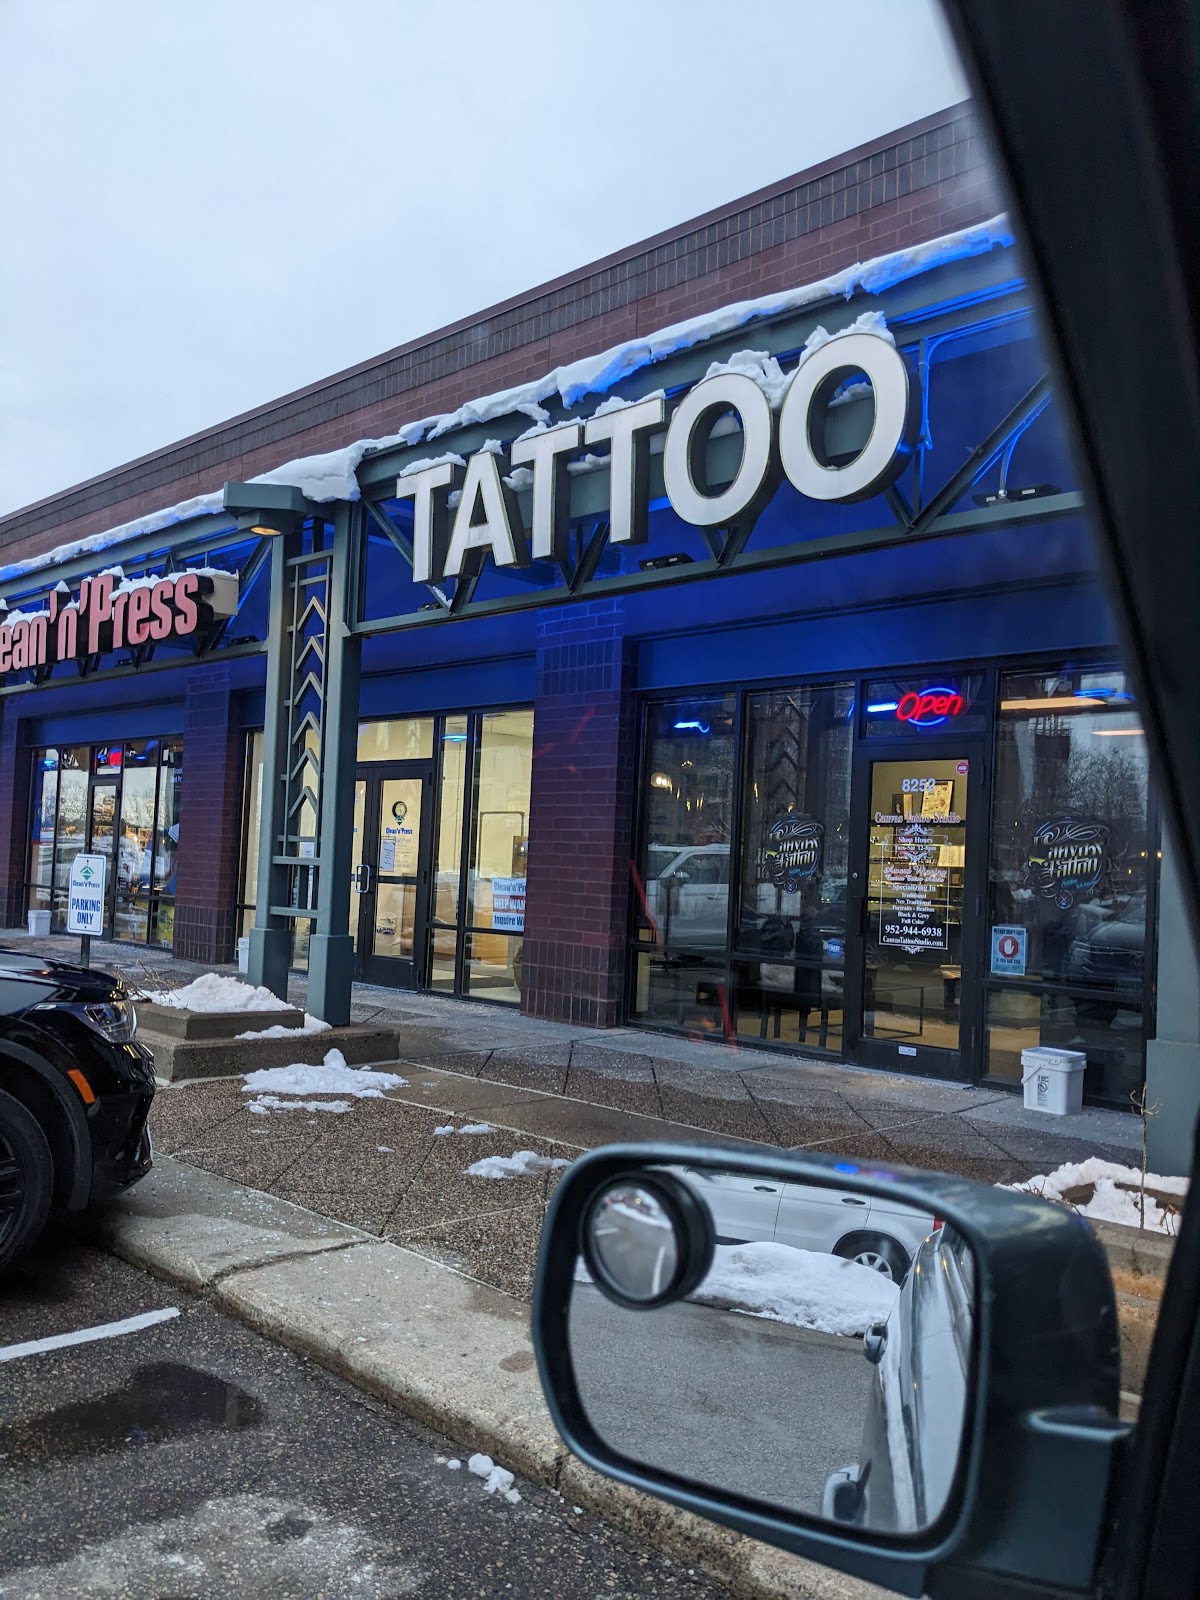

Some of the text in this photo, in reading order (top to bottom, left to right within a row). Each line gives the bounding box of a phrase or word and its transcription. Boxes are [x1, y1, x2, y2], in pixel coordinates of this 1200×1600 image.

[396, 332, 910, 583] TATTOO
[897, 692, 963, 721] Open
[902, 779, 936, 792] 8252
[875, 812, 903, 823] Canvas
[933, 811, 962, 824] Studio
[386, 827, 413, 835] Clean'n'Press
[898, 836, 933, 845] Shop Hours
[892, 884, 927, 892] Specializing
[72, 898, 101, 912] PARKING
[494, 897, 509, 910] HELP
[77, 912, 94, 925] ONLY
[494, 915, 516, 926] Inquire
[885, 925, 942, 937] 952-944-6938
[882, 936, 944, 946] CanvasTattooStudio.com
